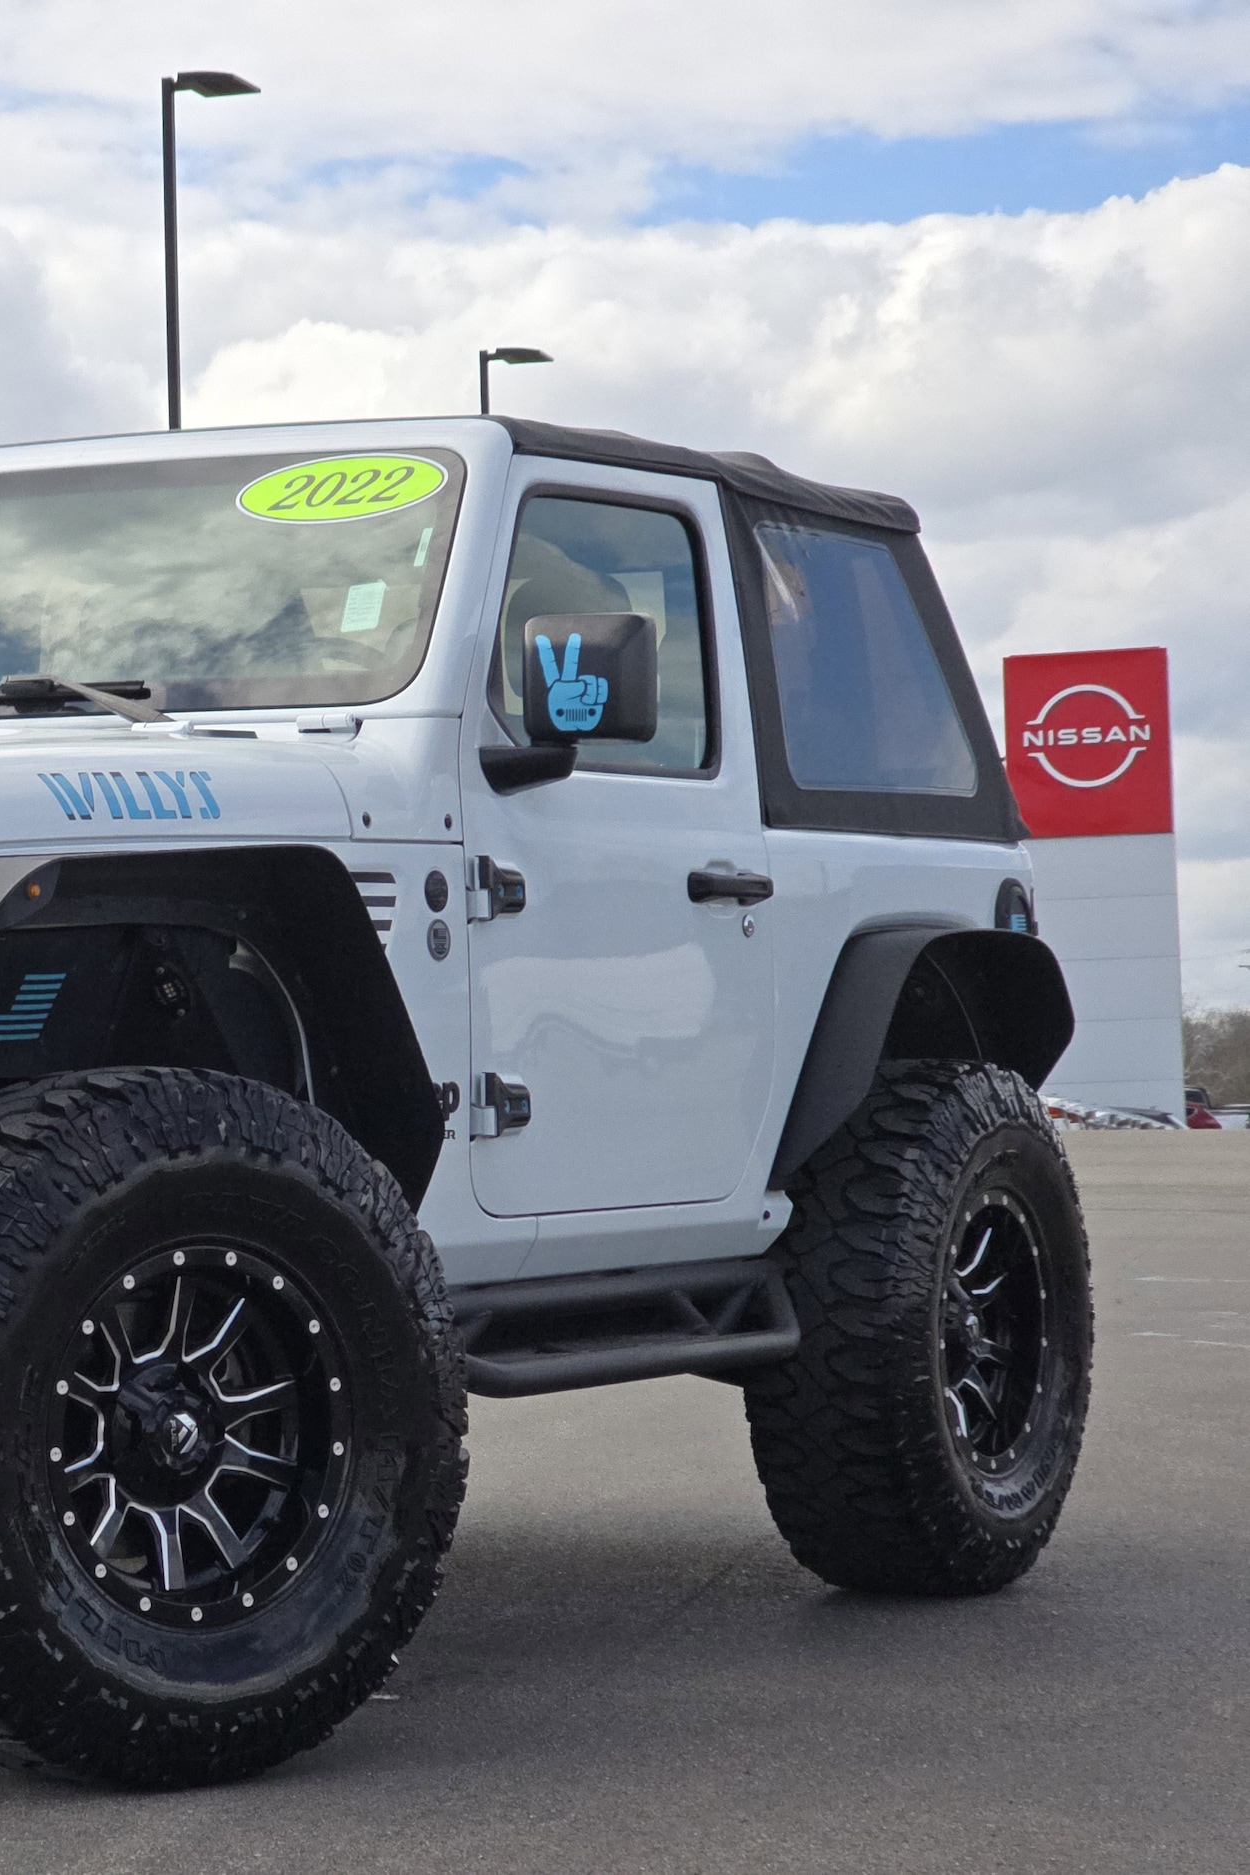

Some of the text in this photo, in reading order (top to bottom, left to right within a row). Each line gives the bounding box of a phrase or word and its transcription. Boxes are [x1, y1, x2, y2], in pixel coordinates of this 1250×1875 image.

[266, 466, 415, 511] 2022
[1022, 724, 1151, 748] NISSAN
[36, 771, 221, 820] WILLYS
[169, 1419, 177, 1451] FUEL
